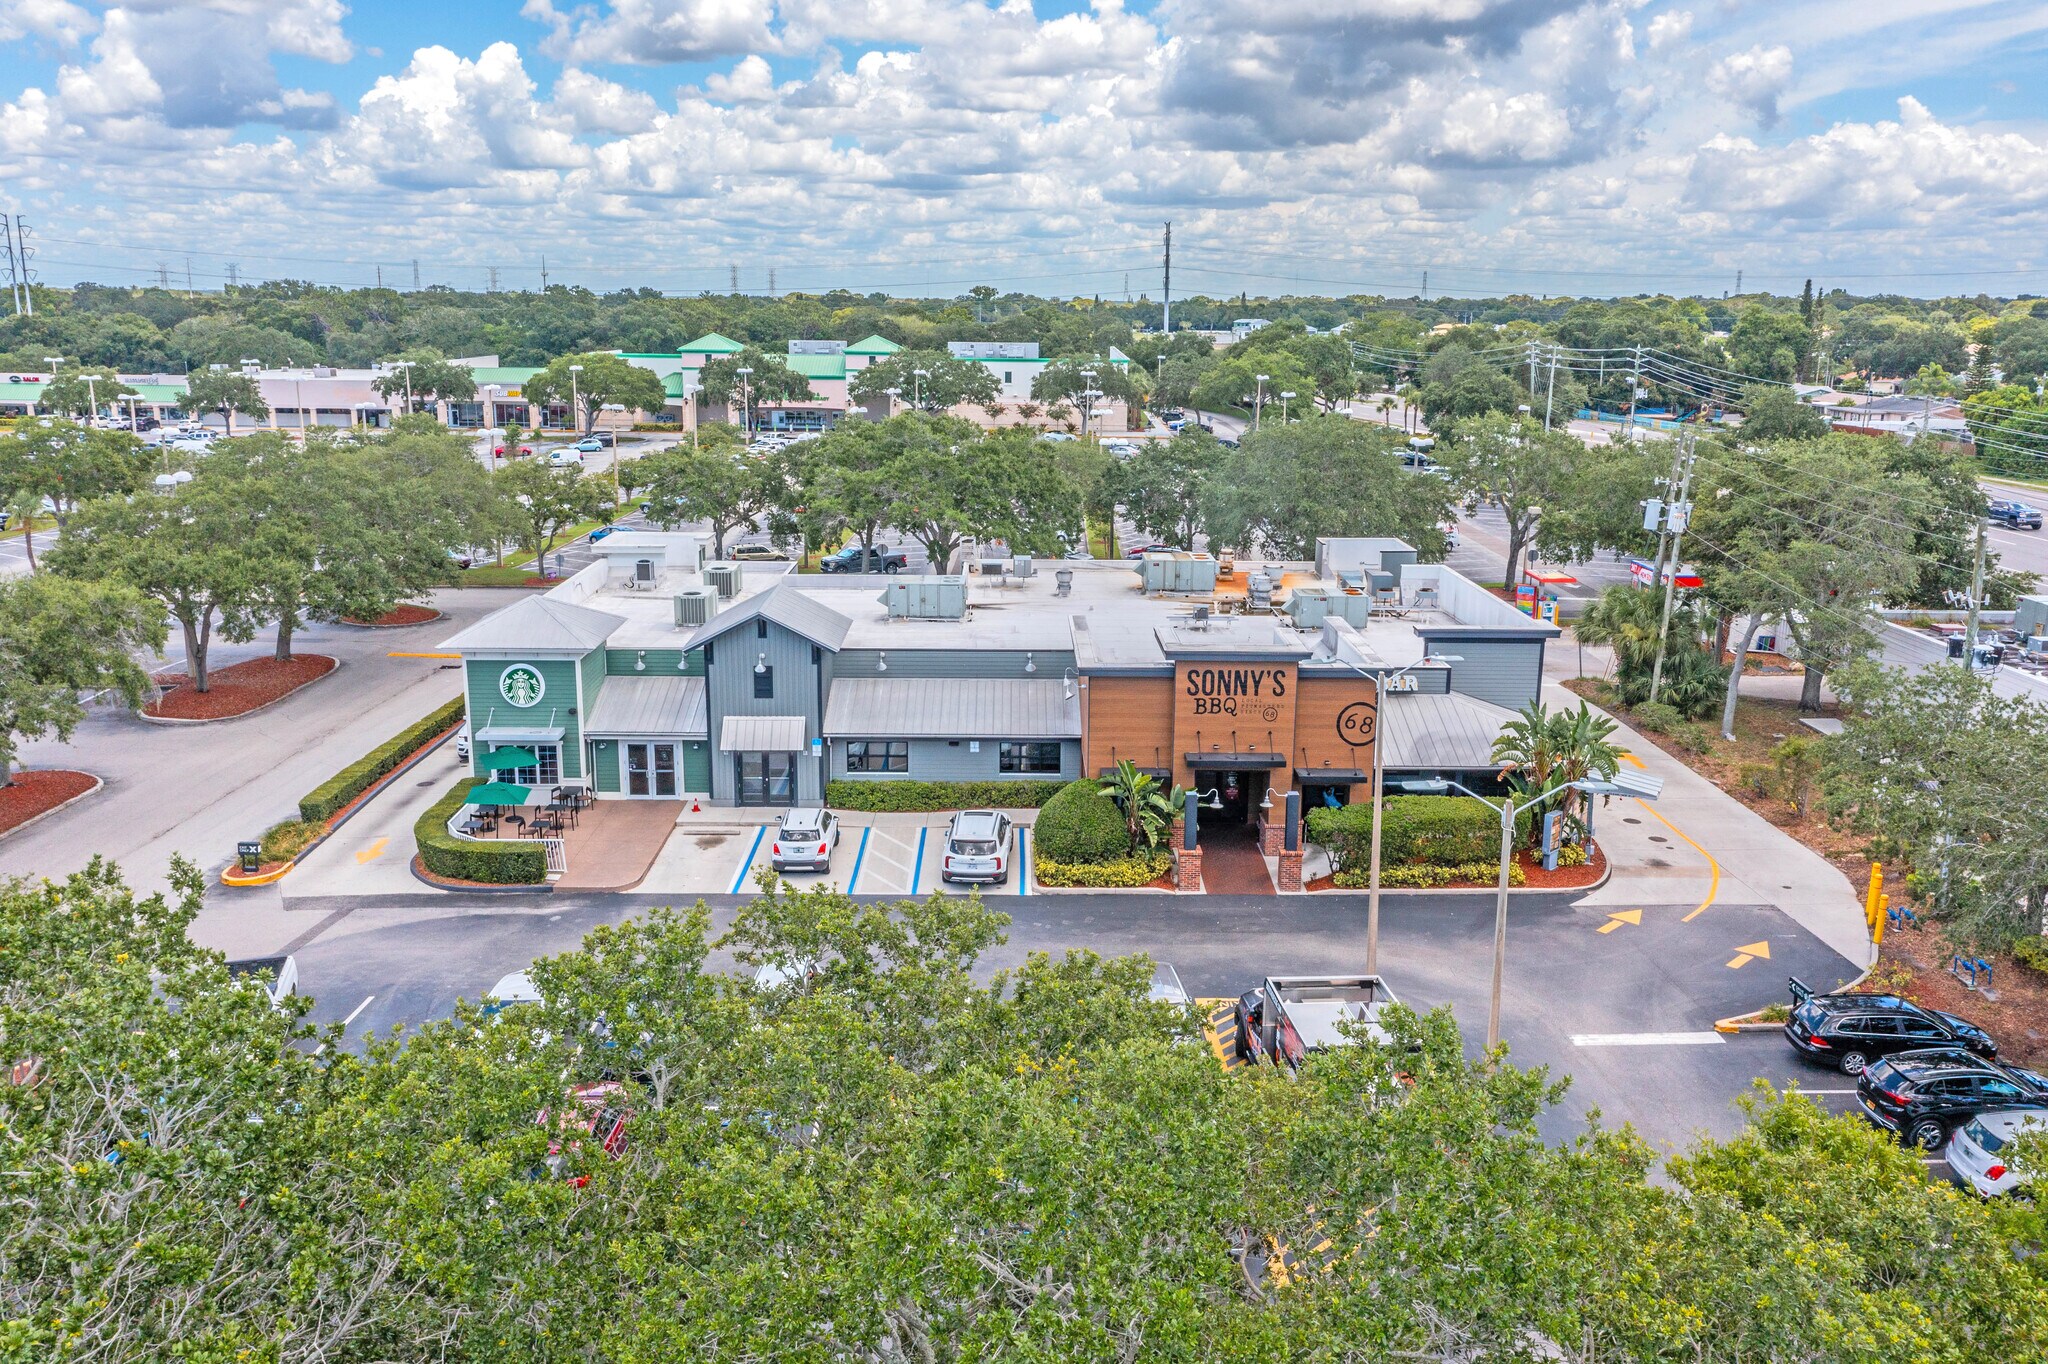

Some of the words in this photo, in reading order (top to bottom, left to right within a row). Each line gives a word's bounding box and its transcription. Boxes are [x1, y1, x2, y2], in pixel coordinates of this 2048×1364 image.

[494, 390, 521, 398] SUBWAY
[1187, 669, 1286, 697] SONNY'S
[1193, 697, 1237, 716] BBQ
[1345, 713, 1373, 734] 68
